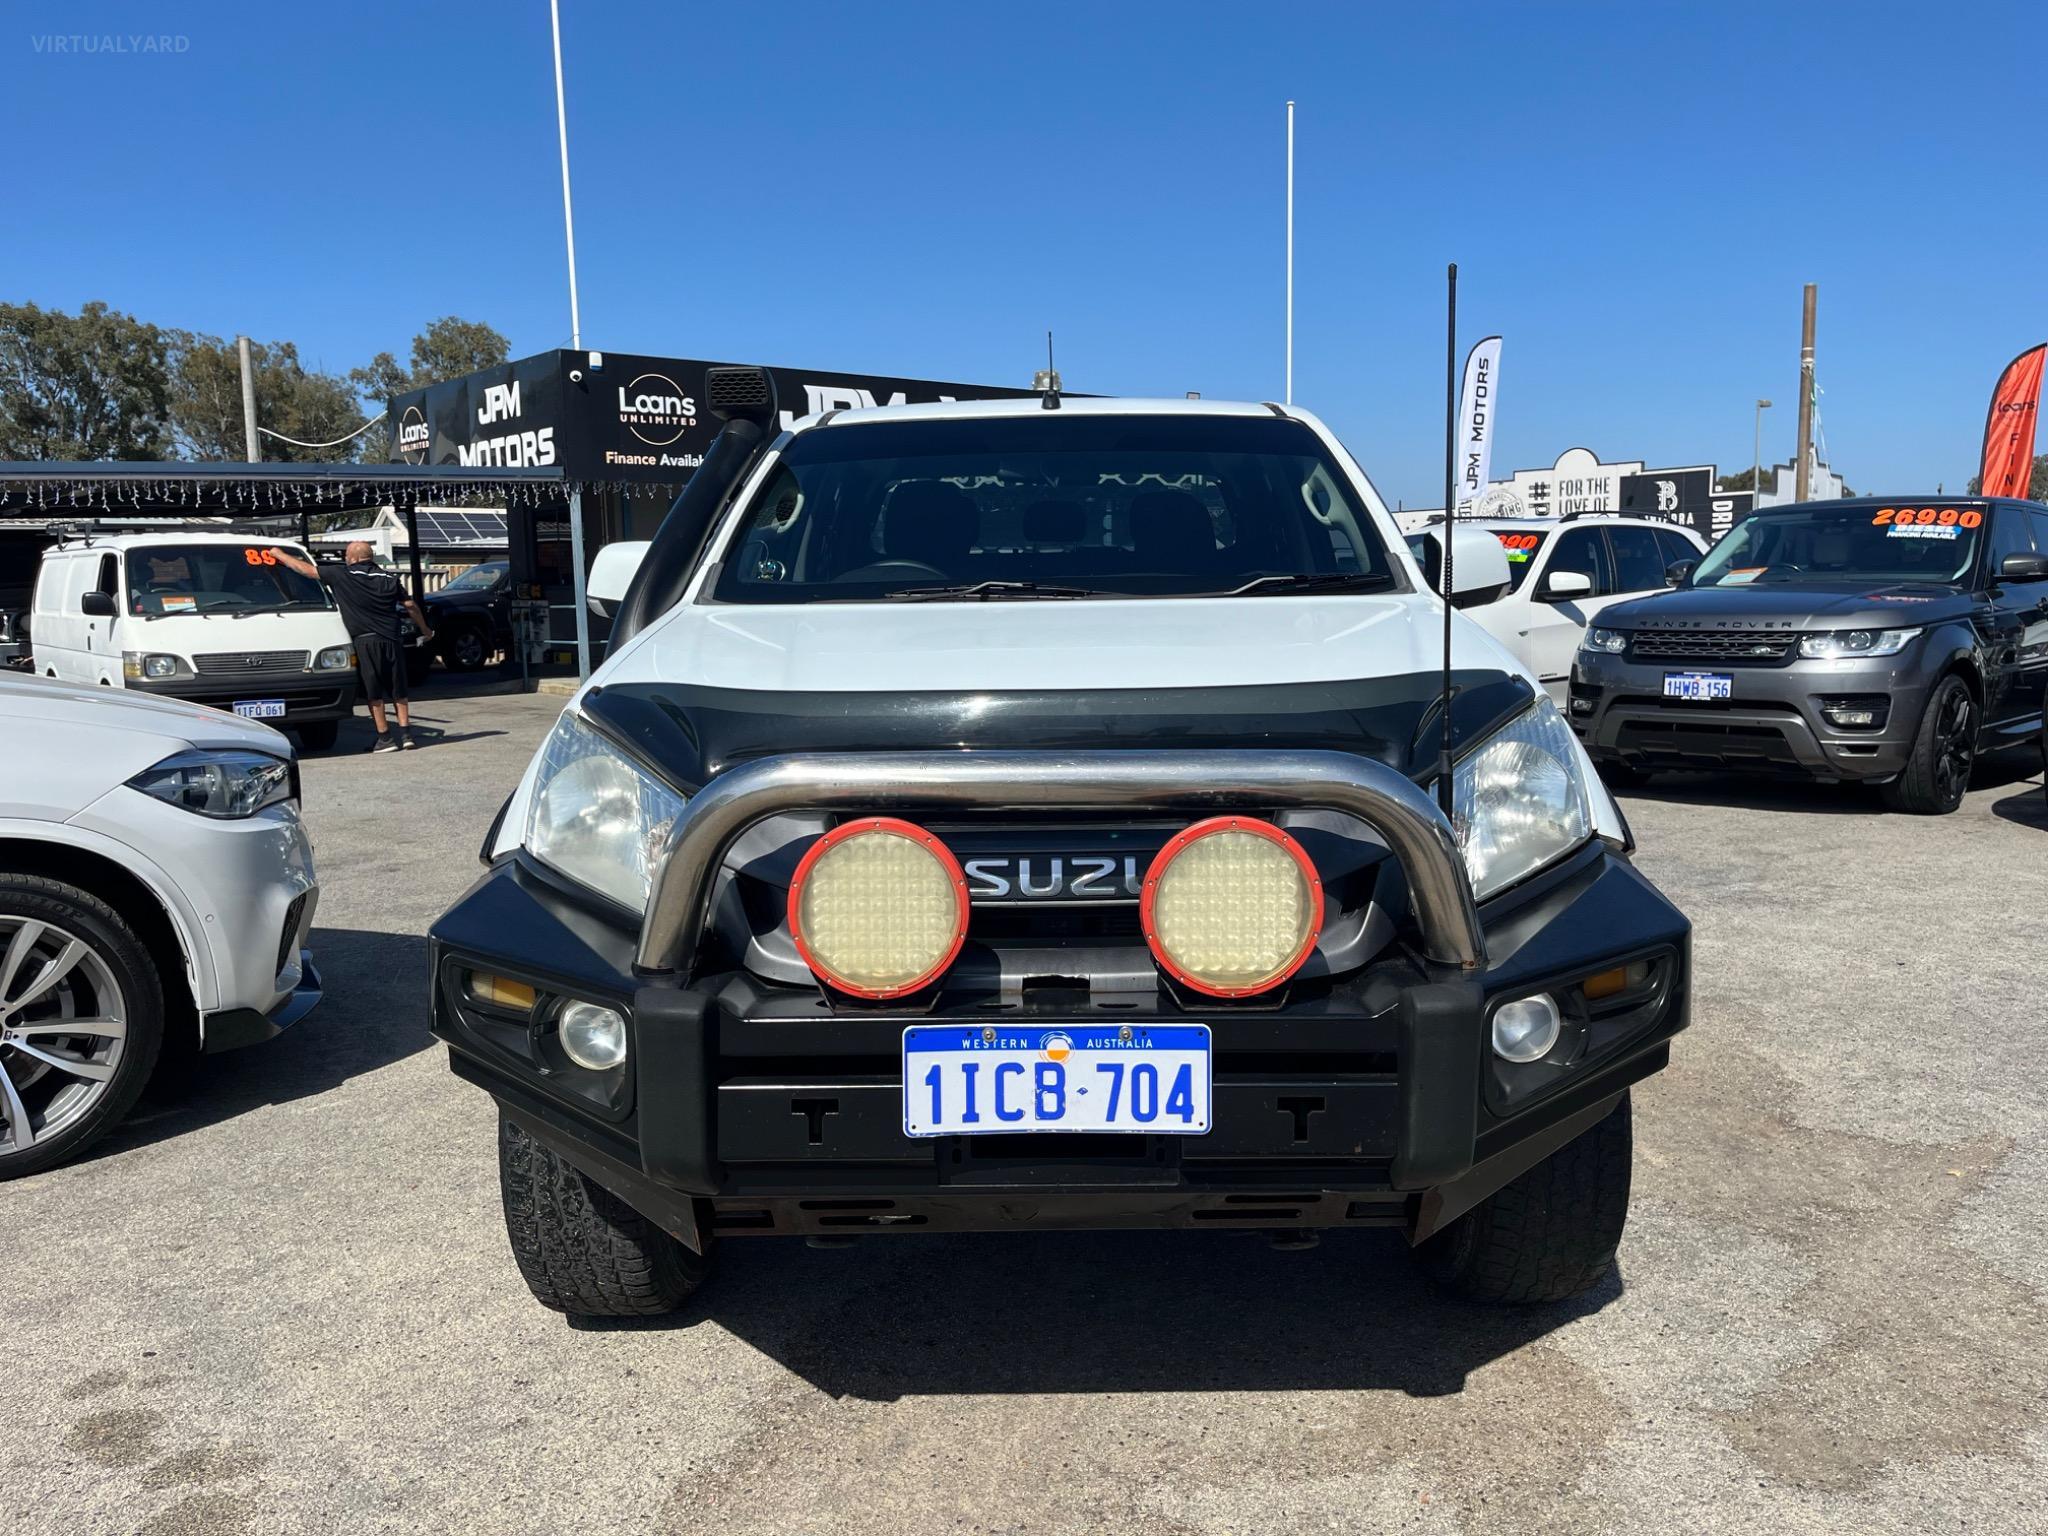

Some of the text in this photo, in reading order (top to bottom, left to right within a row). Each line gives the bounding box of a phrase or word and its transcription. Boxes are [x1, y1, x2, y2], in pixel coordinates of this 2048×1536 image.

[478, 380, 521, 425] JPM
[618, 387, 696, 417] Loans
[619, 414, 697, 427] UNLIMITED
[1466, 358, 1489, 489] JPM MOTORS
[399, 421, 430, 445] Loans
[400, 440, 430, 453] UNLIMITED
[458, 427, 555, 468] MOTORS
[606, 452, 656, 466] Finance
[1559, 477, 1611, 497] FOR THE
[1559, 496, 1609, 516] LOVE OF
[1711, 500, 1733, 546] DRIV
[1872, 508, 1982, 529] 26990
[1667, 680, 1728, 697] 1HWB 156
[962, 1038, 1153, 1049] WESTERN AUSTRALIA
[925, 1062, 1194, 1125] 1ICB 704
